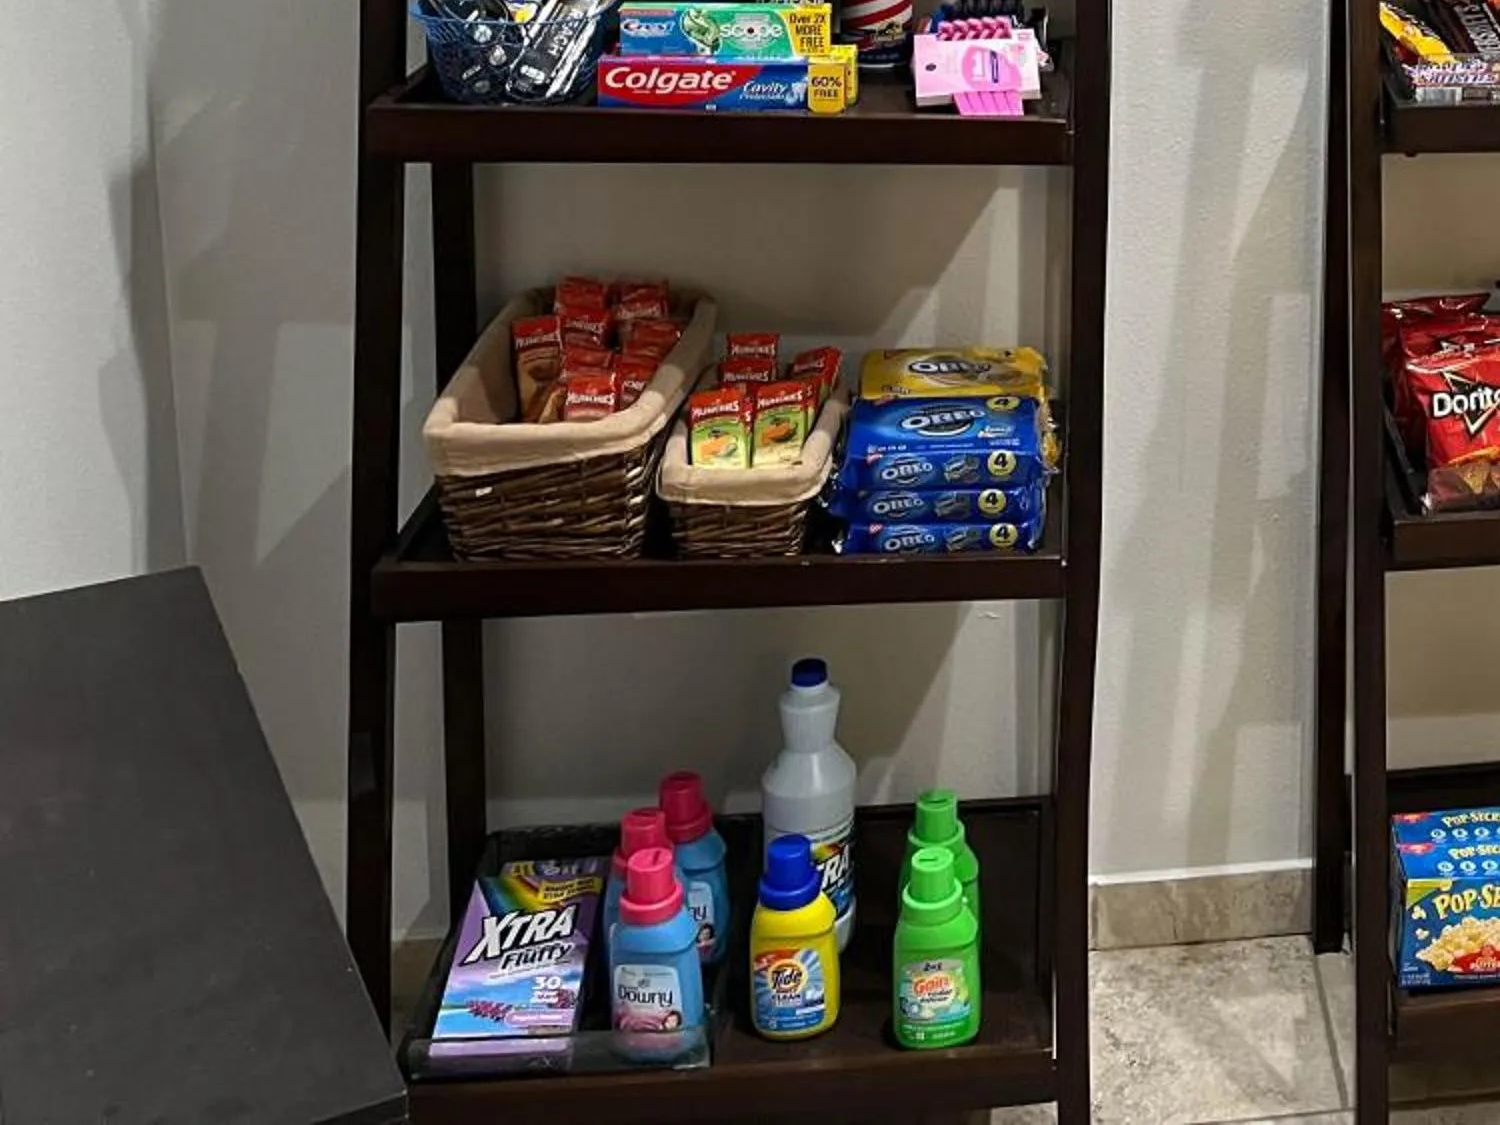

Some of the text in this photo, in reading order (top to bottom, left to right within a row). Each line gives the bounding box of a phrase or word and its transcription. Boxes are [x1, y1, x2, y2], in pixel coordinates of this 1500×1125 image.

[789, 13, 811, 24] Over
[720, 22, 783, 40] scope
[795, 24, 823, 37] MORE
[800, 36, 826, 49] FREE
[605, 65, 733, 94] Colgate
[743, 80, 786, 95] Cavity
[810, 74, 843, 88] 60%
[813, 87, 839, 100] FREE
[900, 409, 986, 430] OREO
[993, 452, 1009, 467] 4
[881, 461, 934, 481] OREO
[873, 496, 925, 514] OREO
[985, 492, 999, 506] 4
[996, 525, 1011, 540] 4
[883, 533, 936, 552] OREO
[462, 904, 578, 965] XTRA
[501, 942, 575, 970] Fluffy
[534, 976, 561, 990] 30
[771, 967, 803, 989] Tide
[913, 976, 951, 996] Gain
[617, 983, 674, 1008] Downy
